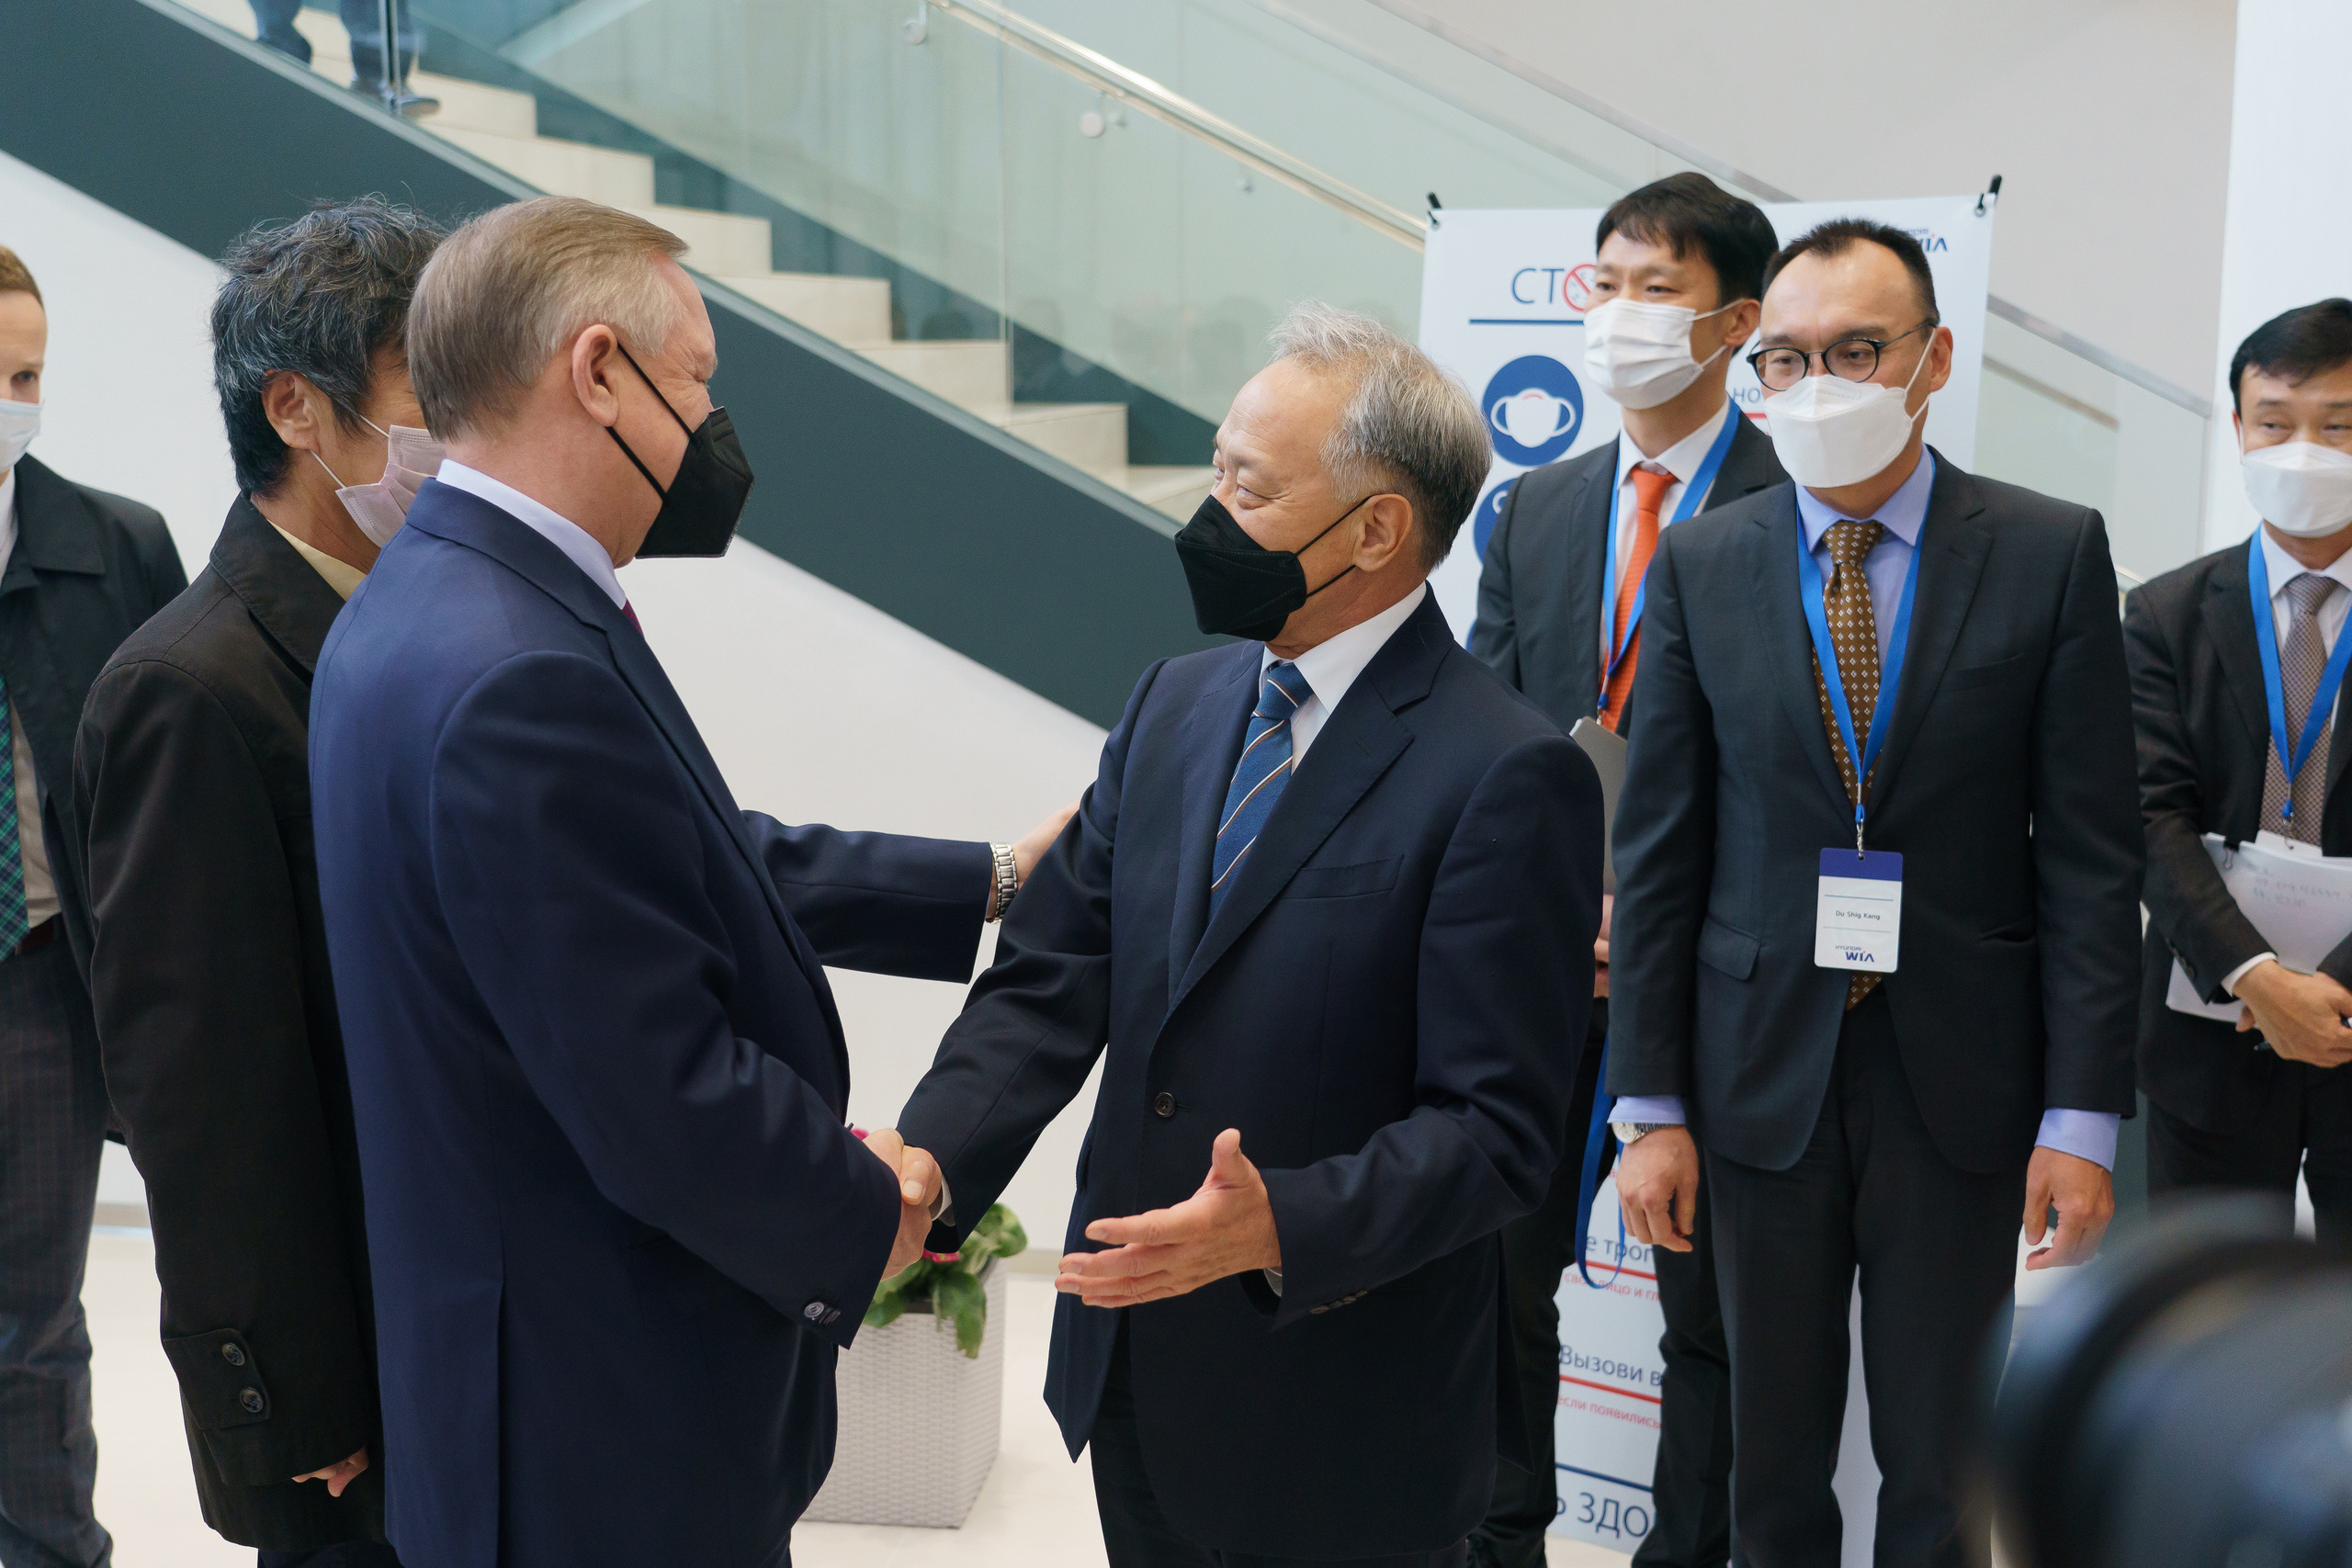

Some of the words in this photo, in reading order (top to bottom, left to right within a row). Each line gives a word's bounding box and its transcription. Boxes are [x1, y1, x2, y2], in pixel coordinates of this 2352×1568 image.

[1920, 237, 1948, 252] IA
[1863, 912, 1881, 920] Kang
[1845, 951, 1875, 963] WIA
[1559, 1344, 1644, 1383] Вызови
